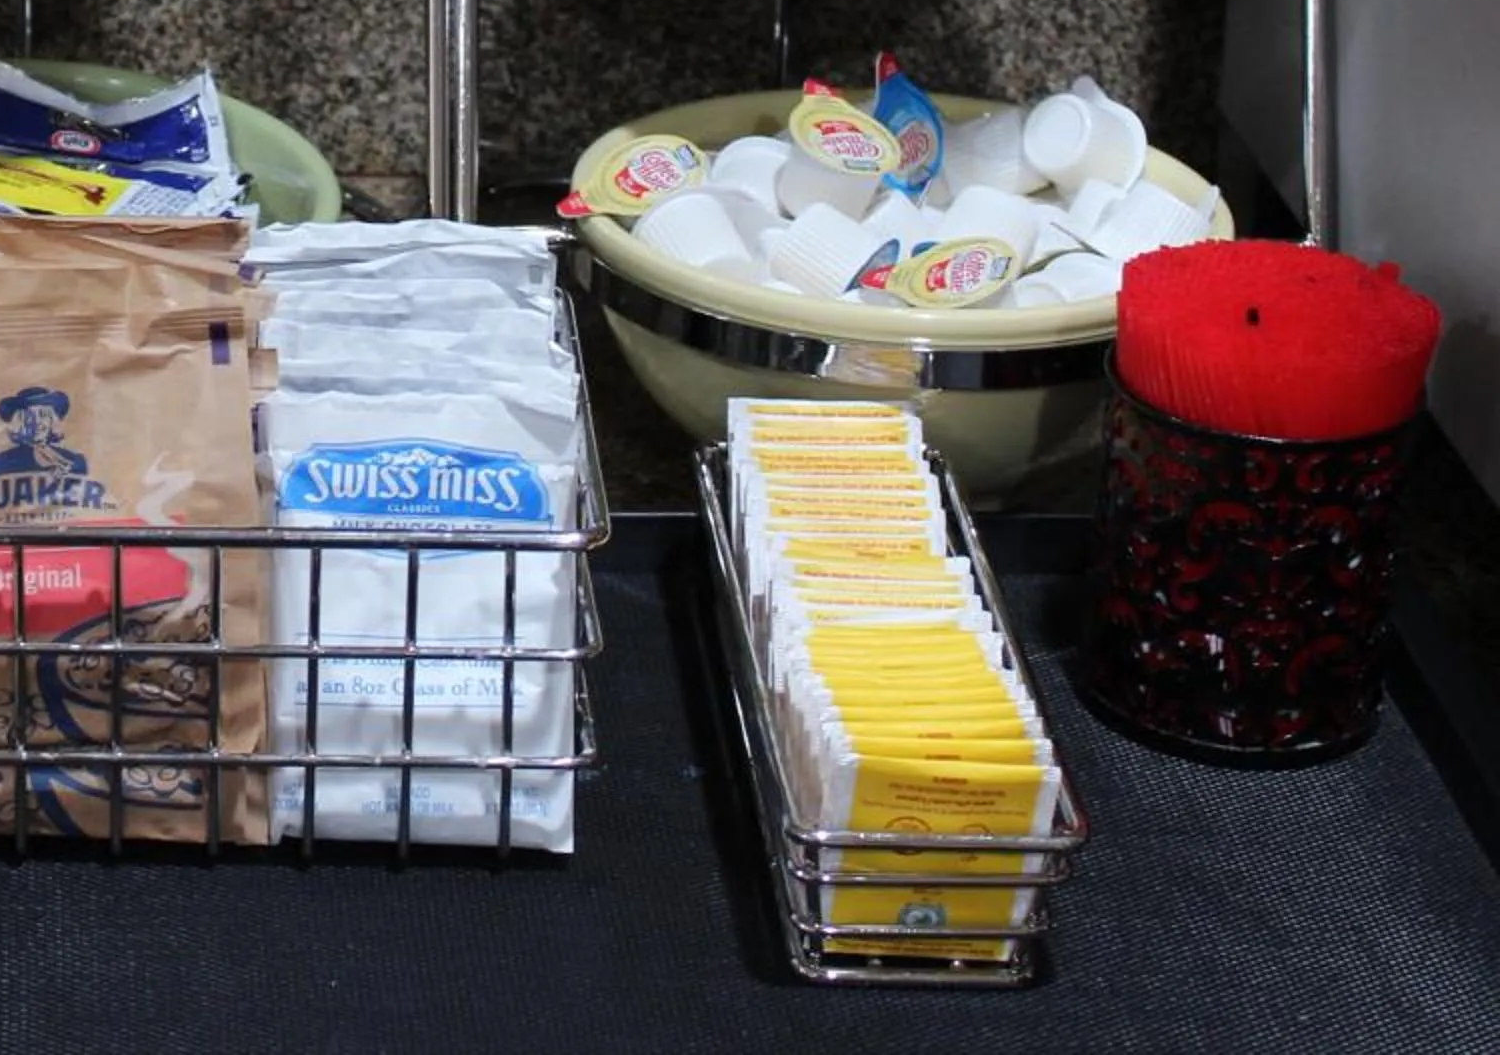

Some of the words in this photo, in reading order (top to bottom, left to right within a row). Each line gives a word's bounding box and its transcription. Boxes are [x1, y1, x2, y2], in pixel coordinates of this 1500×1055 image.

[304, 458, 421, 503] SWISS
[428, 464, 520, 512] MISS
[387, 504, 441, 514] CLASSICS
[322, 681, 345, 694] an
[351, 676, 383, 695] 8oz
[392, 677, 447, 696] Gass
[451, 677, 471, 696] of
